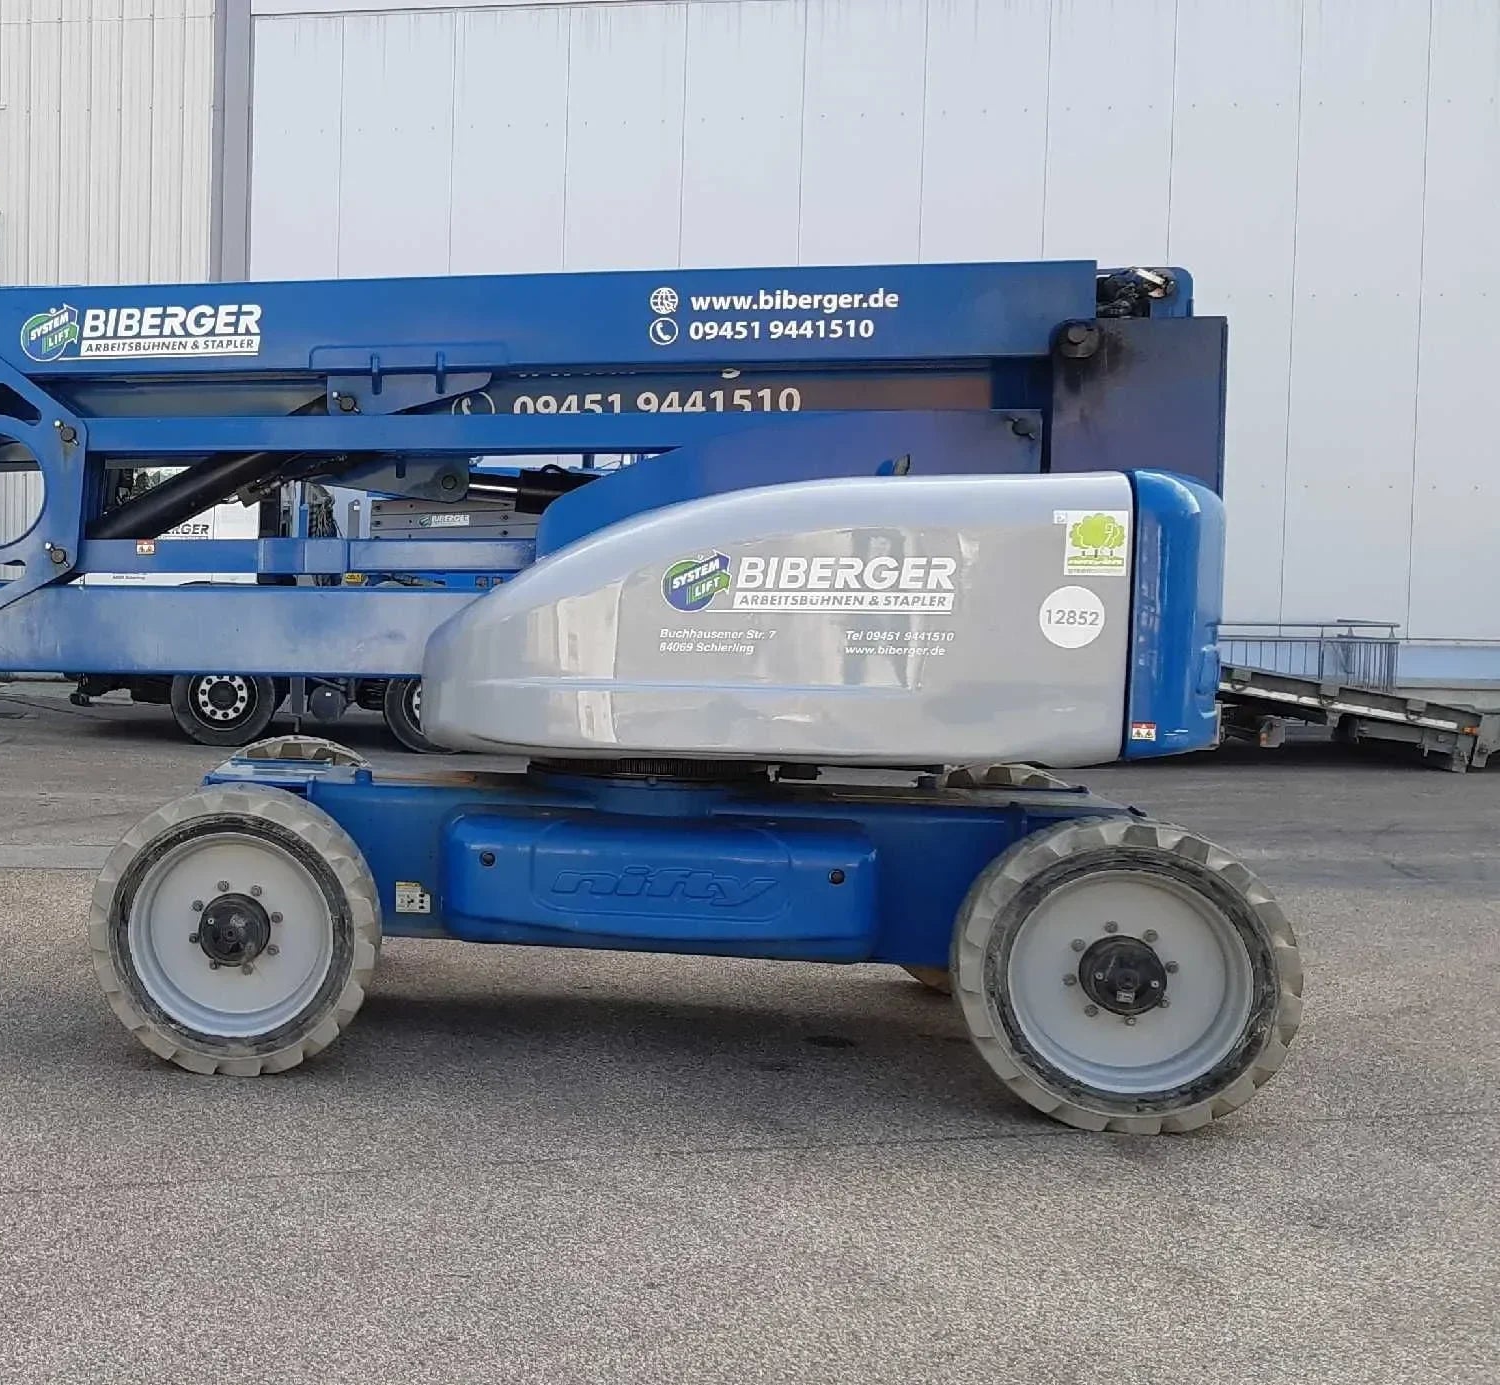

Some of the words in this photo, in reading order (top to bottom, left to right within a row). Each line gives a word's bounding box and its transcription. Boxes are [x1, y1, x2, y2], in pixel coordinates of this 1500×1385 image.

[690, 288, 899, 313] www.biberger.de
[30, 311, 70, 341] SYSTEM
[82, 305, 262, 338] BIBERGER
[689, 321, 761, 341] 09451
[769, 319, 875, 340] 9441510
[48, 328, 71, 347] LIFT
[85, 341, 188, 354] ARBEITSBÜHNEN
[191, 340, 201, 350] &
[203, 338, 255, 350] STAPLER
[672, 558, 720, 589] SYSTEM
[736, 557, 957, 590] BIBERGER
[694, 577, 720, 598] LIFT
[740, 595, 864, 606] ARBEITSBÜHNEN
[868, 595, 880, 606] &
[883, 595, 947, 607] STAPLER
[1046, 609, 1100, 626] 12852
[660, 628, 743, 639] Buchhausener
[746, 628, 765, 640] Str.
[768, 630, 778, 639] 7
[845, 630, 863, 641] Tel
[866, 630, 901, 641] 09451
[904, 631, 956, 642] 9441510
[696, 642, 755, 656] Schierling
[845, 645, 947, 658] www.biberger.de
[551, 865, 781, 907] nifty
